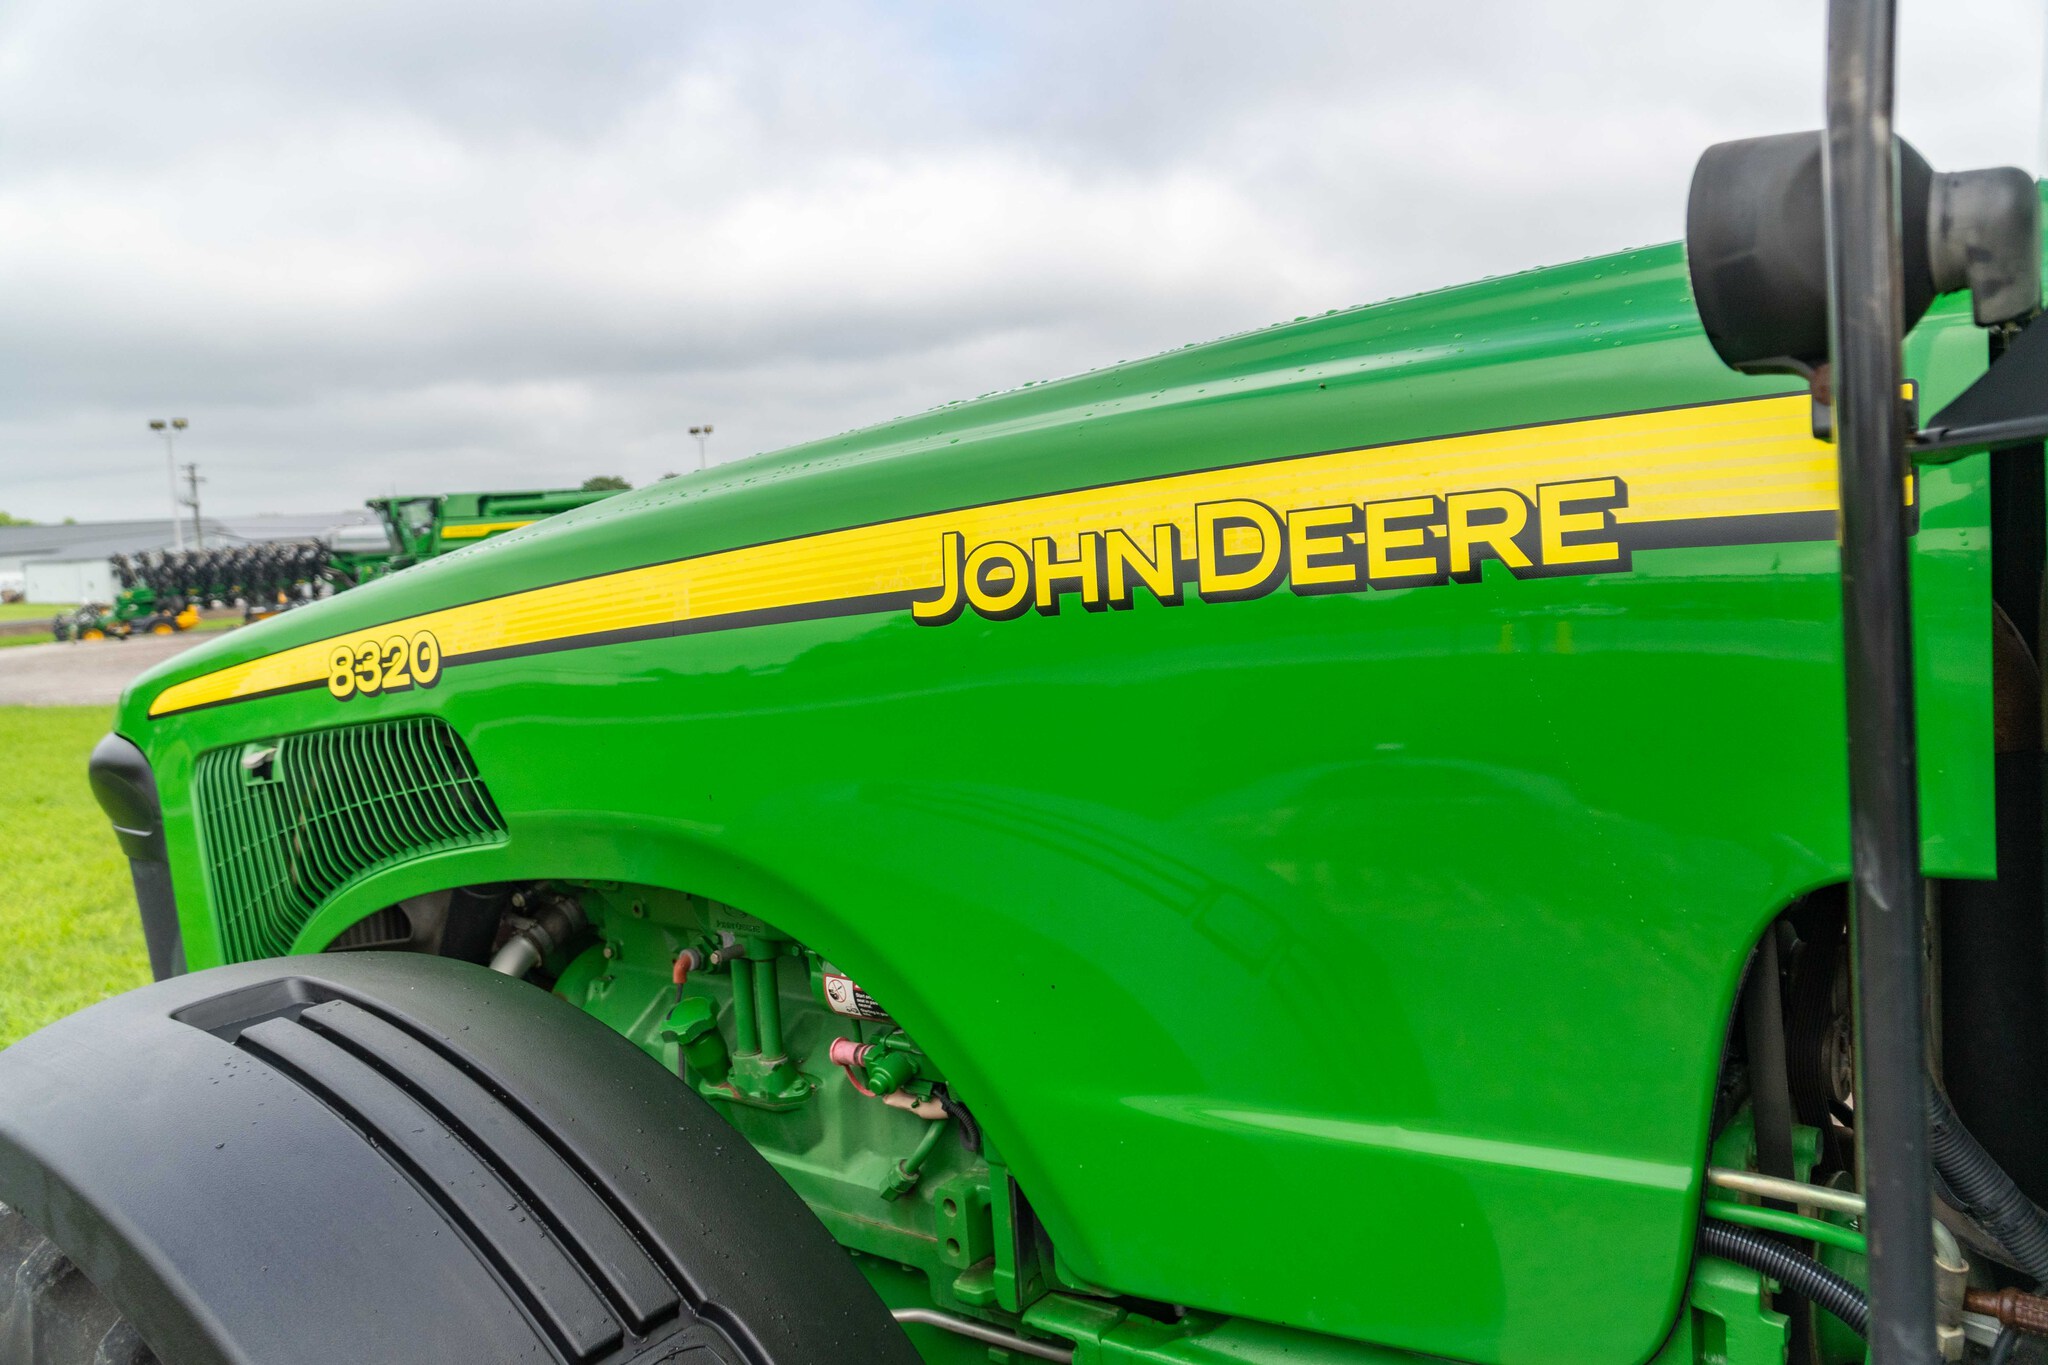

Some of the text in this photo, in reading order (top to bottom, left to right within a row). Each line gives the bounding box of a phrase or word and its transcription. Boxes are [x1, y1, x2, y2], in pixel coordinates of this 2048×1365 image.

[911, 478, 1624, 622] JOHN DEERE
[328, 630, 441, 699] 8320
